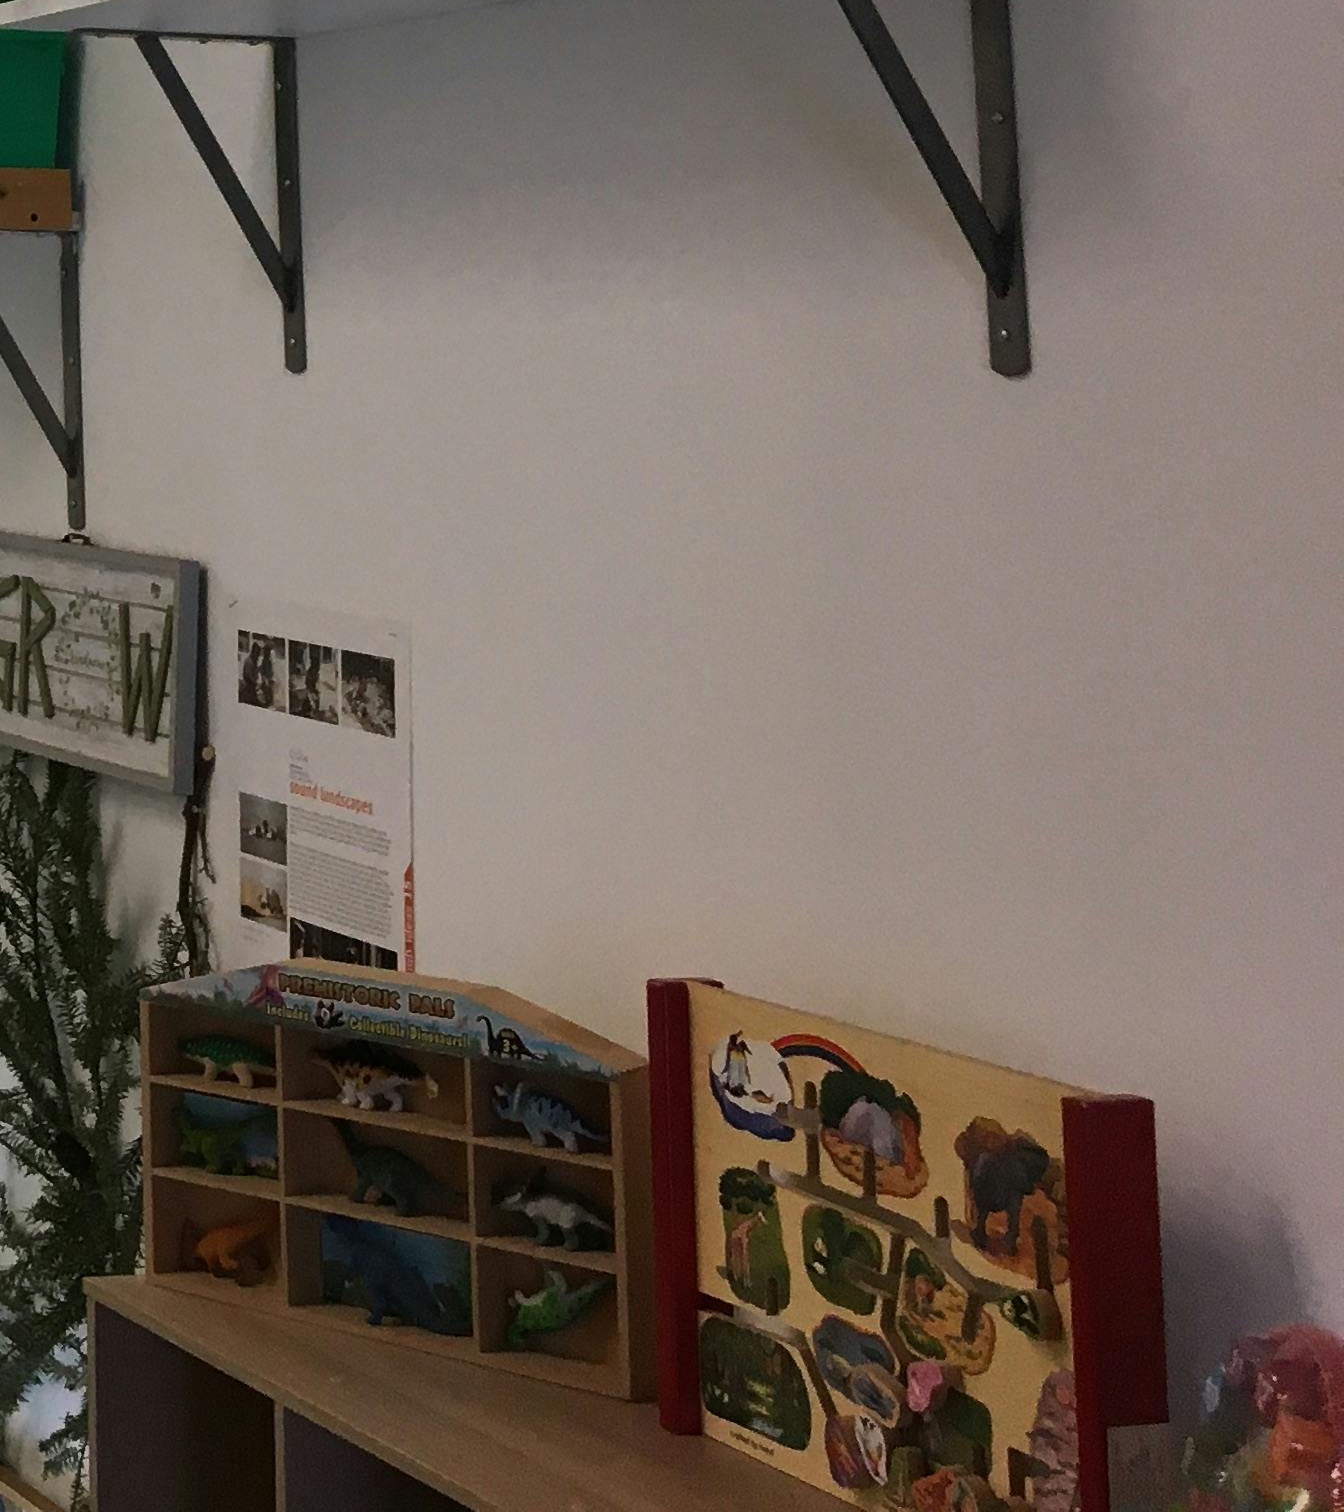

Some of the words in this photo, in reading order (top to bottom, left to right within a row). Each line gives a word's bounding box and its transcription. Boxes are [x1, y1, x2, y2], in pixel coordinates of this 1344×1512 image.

[289, 781, 318, 800] sound
[320, 785, 374, 816] landscapes
[277, 971, 401, 1010] PREHISTORIC
[407, 992, 456, 1020] PALS
[266, 1001, 310, 1023] Includes
[349, 1015, 406, 1040] Collectible
[409, 1024, 471, 1049] Dinosaurs!
